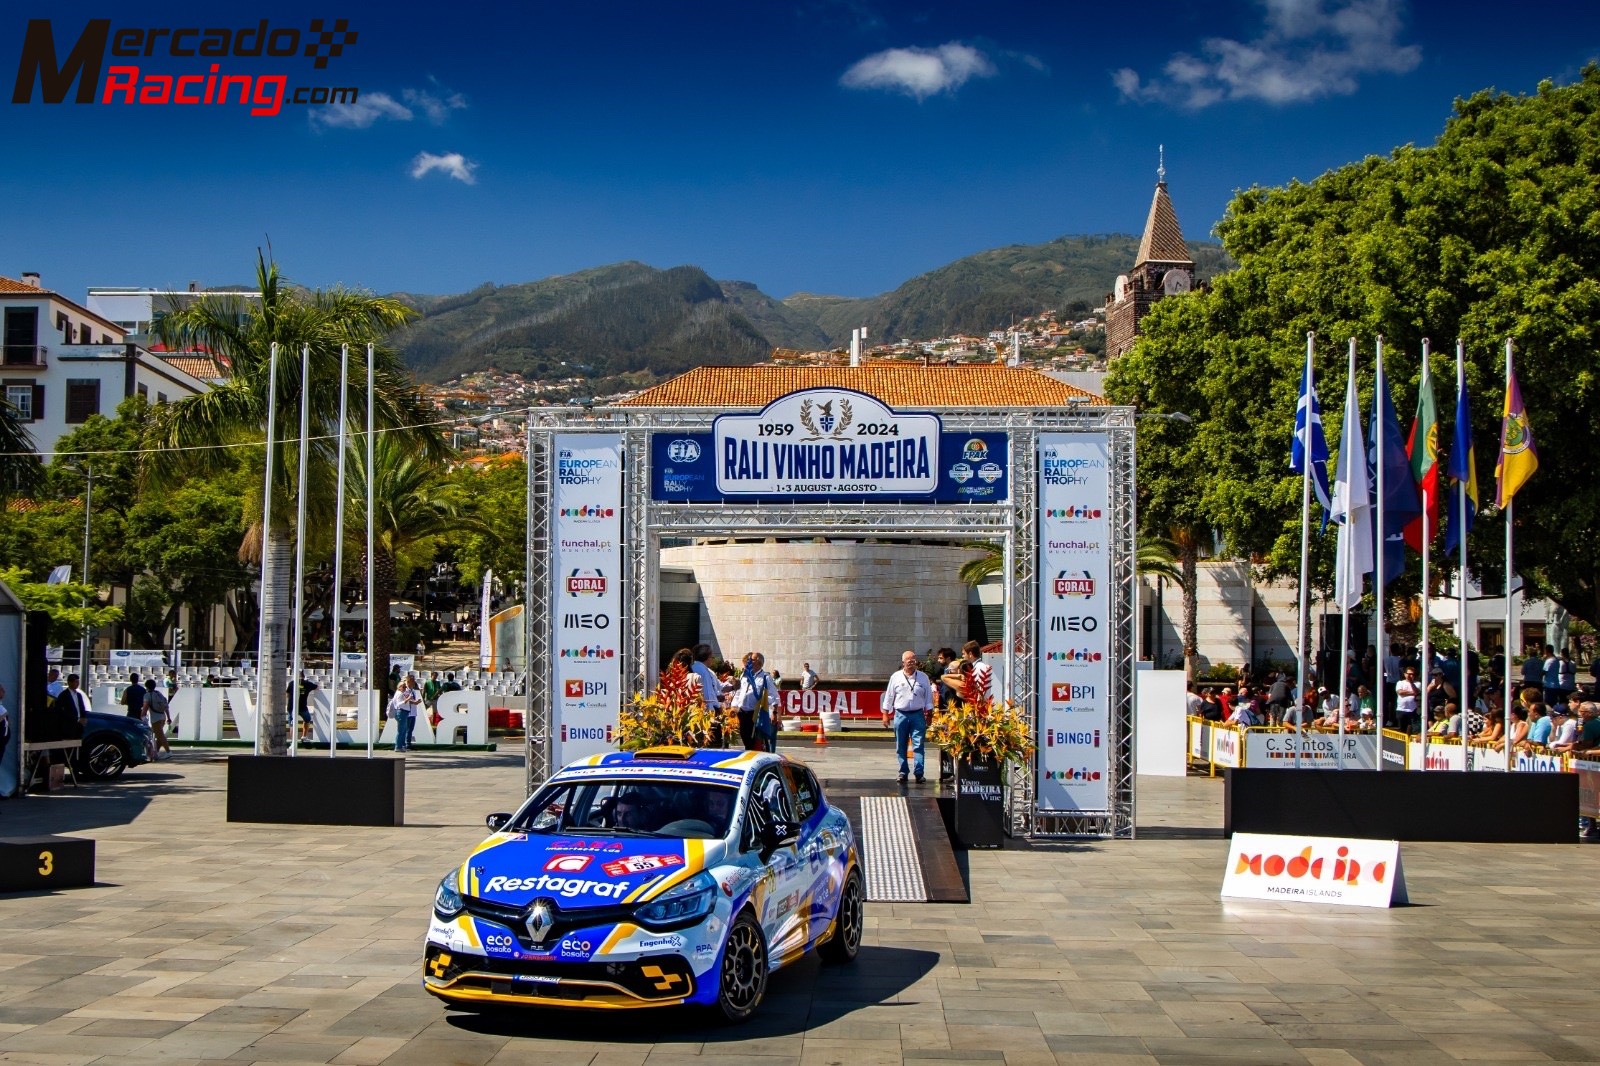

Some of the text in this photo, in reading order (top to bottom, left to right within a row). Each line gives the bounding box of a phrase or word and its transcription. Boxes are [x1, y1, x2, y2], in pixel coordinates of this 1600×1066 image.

[758, 424, 899, 436] 1959 2024
[560, 450, 573, 458] FIA
[670, 444, 698, 458] FIA
[725, 435, 930, 479] RALI VINHO MADEIRA
[560, 460, 618, 468] EUROPEAN
[1044, 460, 1105, 468] EUROPEAN
[560, 469, 592, 477] RALLY
[1045, 468, 1078, 476] RALLY
[560, 477, 602, 485] TROPHY
[1045, 477, 1089, 485] TROPHY
[562, 540, 611, 549] funchal.pt
[1048, 541, 1100, 550] funchal.pt
[571, 580, 604, 590] CORAL
[1058, 581, 1092, 592] CORAL
[564, 614, 610, 629] MEO
[1050, 616, 1098, 632] MEO
[585, 682, 607, 695] BPI
[1071, 686, 1095, 699] BPI
[787, 690, 863, 714] CORAL
[570, 728, 604, 740] BINGO
[1057, 733, 1092, 744] BINGO
[1266, 739, 1280, 751] C.
[1323, 752, 1357, 760] MADIRA
[961, 785, 1001, 795] MADEIRA
[981, 793, 1002, 801] Wine
[38, 851, 53, 876] 3
[485, 874, 630, 899] Restagraf
[1267, 886, 1343, 898] MADEIRA ISLANDS
[487, 936, 512, 946] eco
[562, 940, 591, 950] eco
[562, 950, 590, 958] basalto
